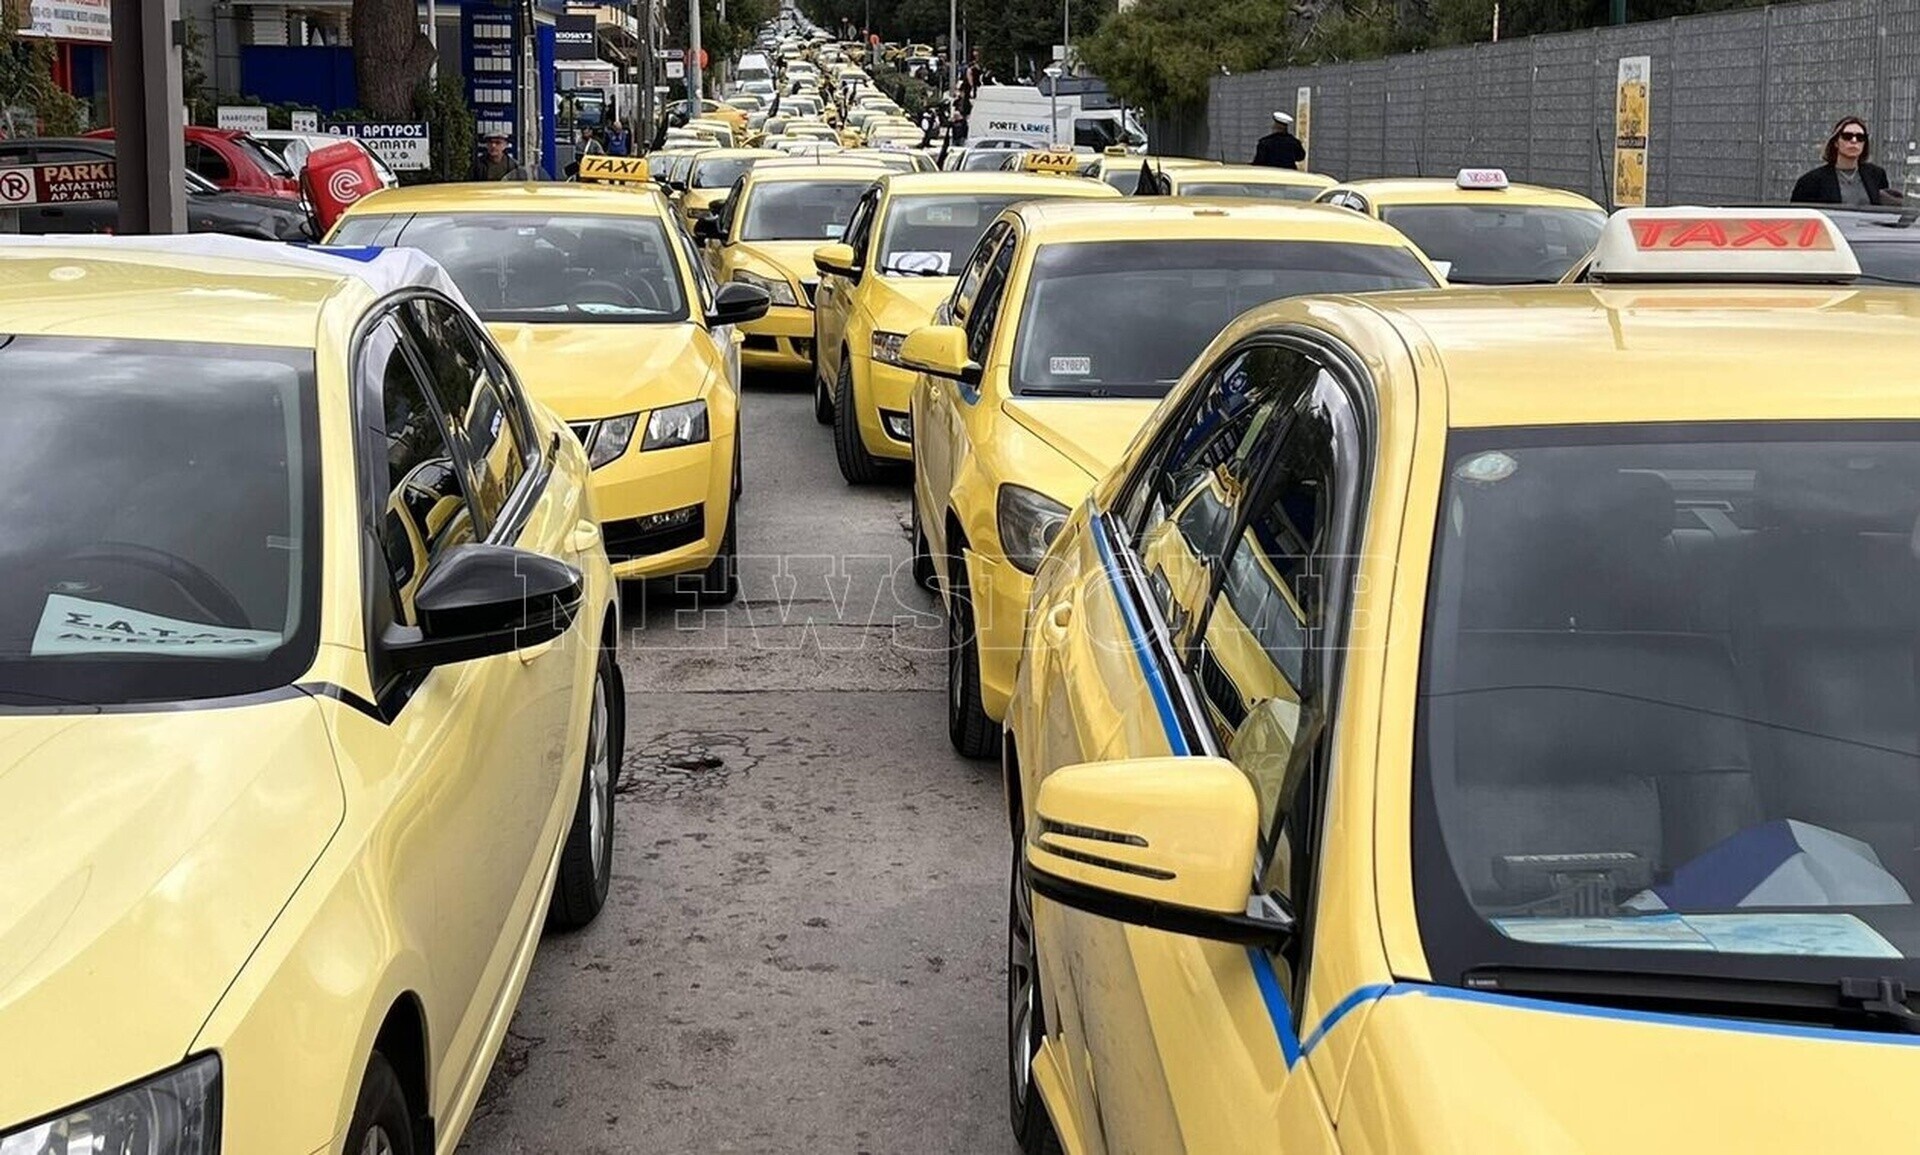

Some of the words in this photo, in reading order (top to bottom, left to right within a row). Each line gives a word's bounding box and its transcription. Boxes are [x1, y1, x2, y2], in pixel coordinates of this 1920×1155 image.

[363, 125, 423, 137] ΑΡΓΥΡΟΣ
[586, 158, 642, 174] TAXI
[1029, 153, 1073, 166] TAXI
[1635, 219, 1821, 248] TAXI
